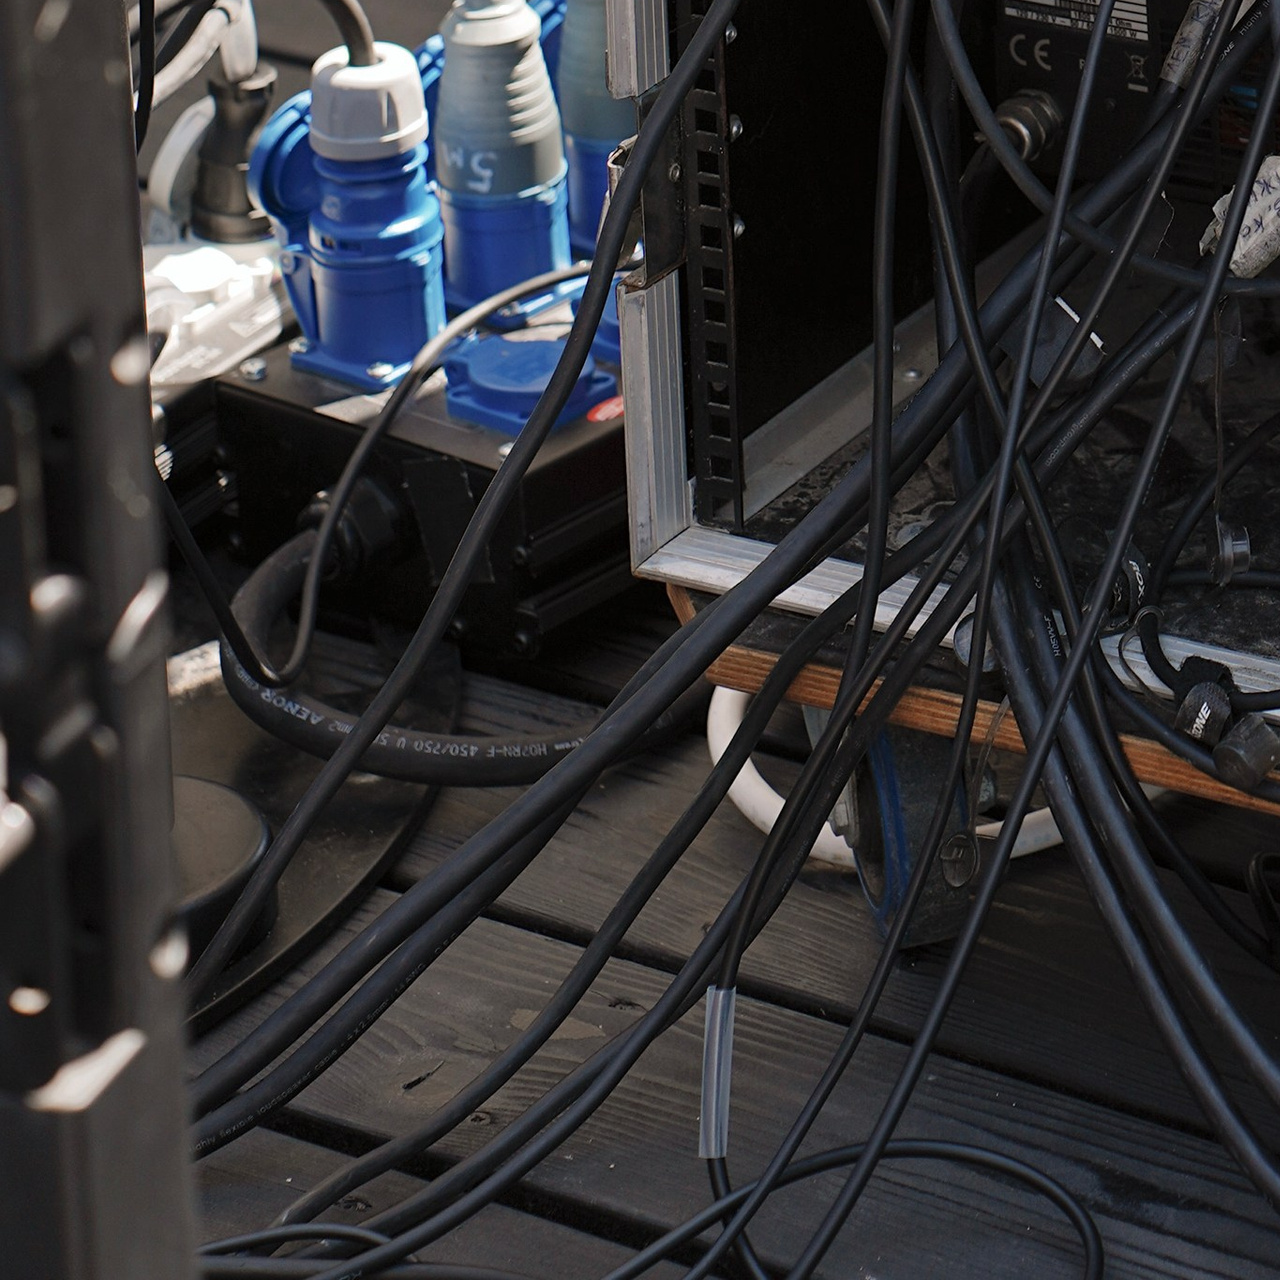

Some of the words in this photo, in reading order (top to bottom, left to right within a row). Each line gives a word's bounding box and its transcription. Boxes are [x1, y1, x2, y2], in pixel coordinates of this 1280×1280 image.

[260, 688, 325, 726] AENOR
[413, 739, 479, 757] 450/750
[486, 743, 548, 758] H07RN-F
